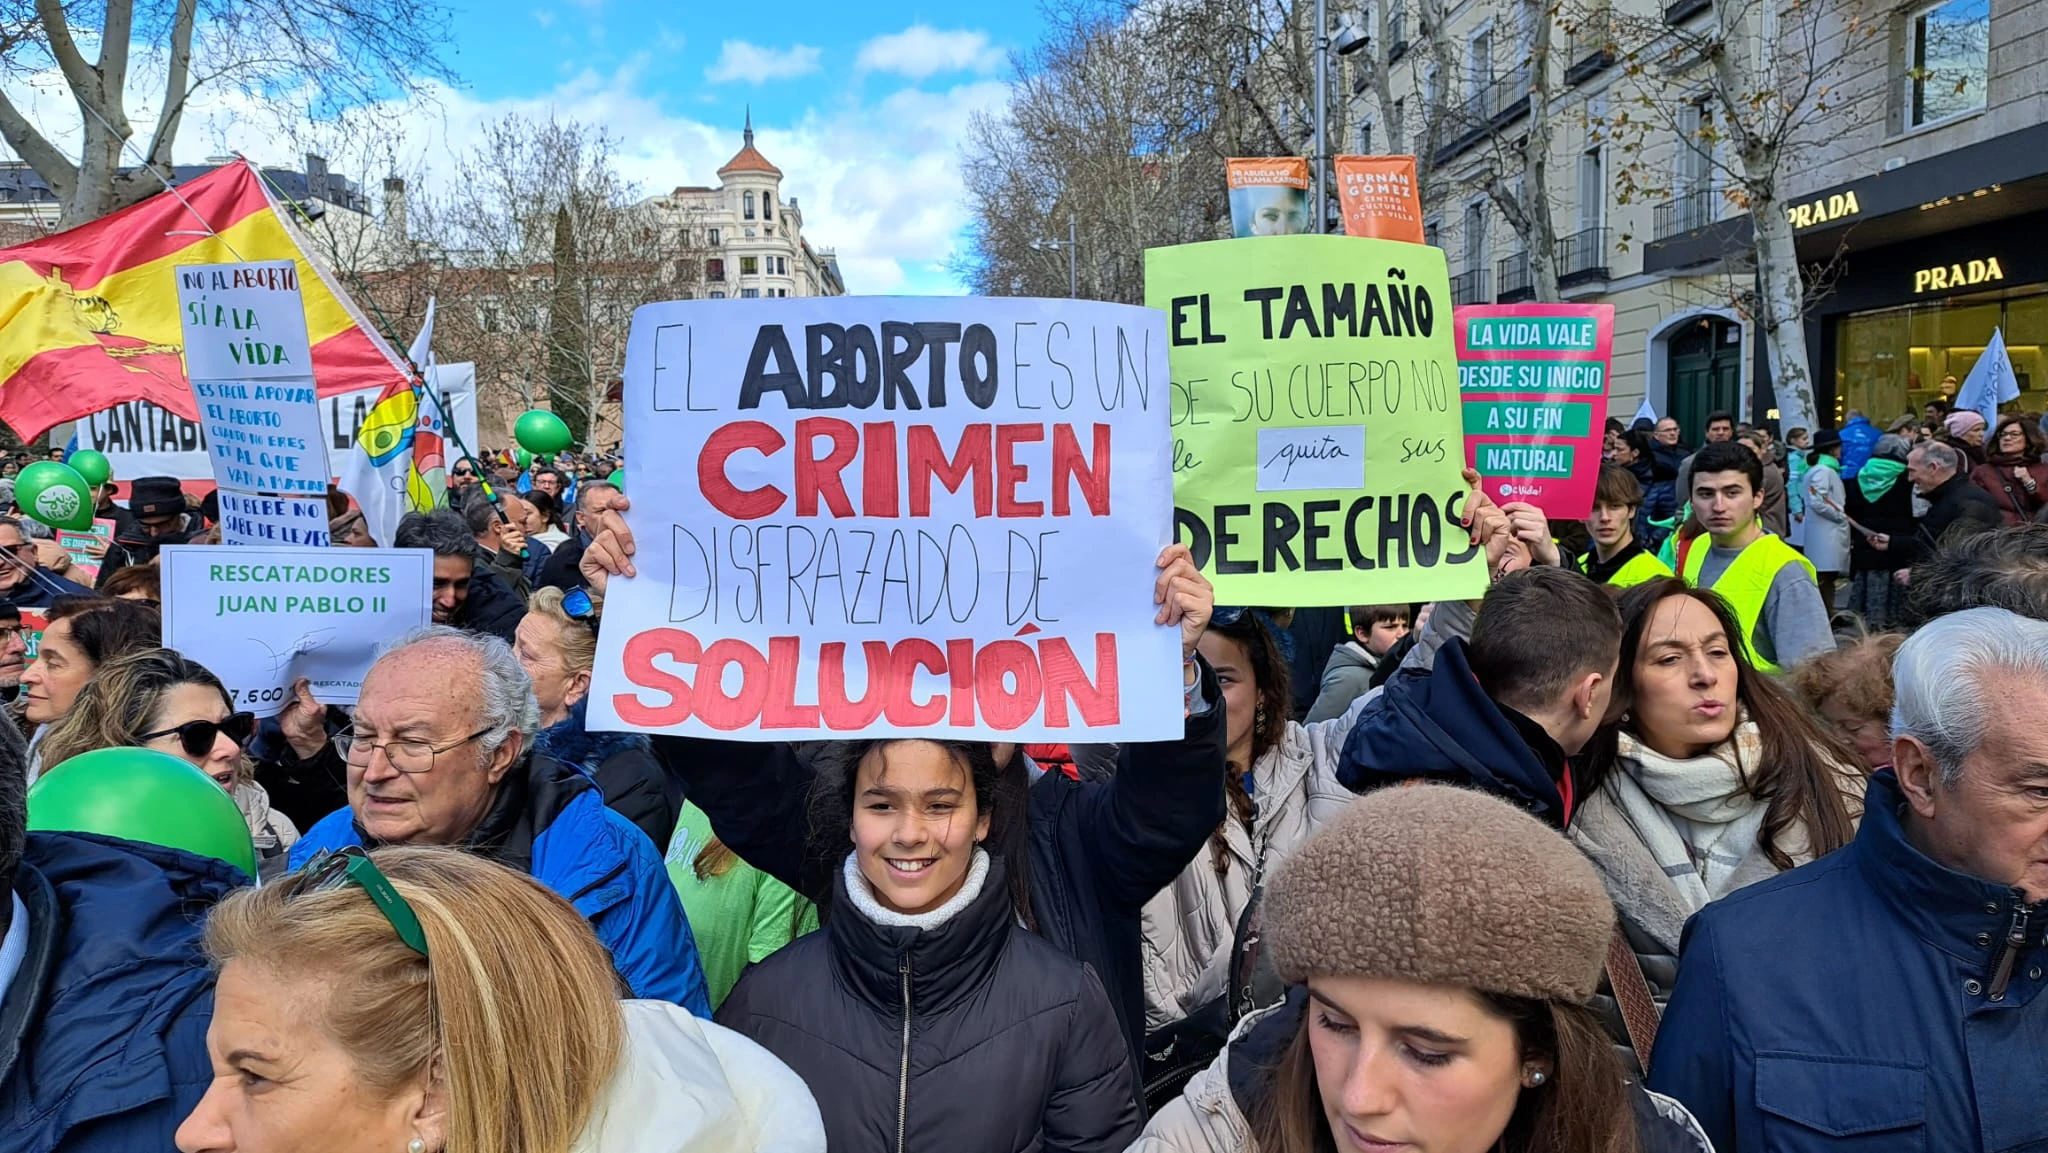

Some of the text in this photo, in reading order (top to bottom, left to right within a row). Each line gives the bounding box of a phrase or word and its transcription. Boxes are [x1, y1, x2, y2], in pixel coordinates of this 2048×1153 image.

[1347, 171, 1409, 185] FERNÁN
[1349, 182, 1410, 198] GÓMEZ
[1360, 203, 1407, 212] CULTURAL
[1364, 196, 1401, 204] CENTRO
[1353, 212, 1366, 220] DE
[1388, 212, 1414, 222] VILLA
[183, 268, 299, 292] NO AL ABORTO
[1914, 256, 2003, 293] PRADA
[188, 294, 261, 332] SÍ A LA
[1172, 266, 1434, 346] EL TAMAÑO
[1472, 324, 1592, 346] LA VIDA VALE
[653, 320, 1150, 412] EL ABORTO ES UN
[1458, 366, 1602, 389] DESDE SU INICIO
[197, 384, 214, 397] ES
[254, 385, 315, 404] APOYAR
[1170, 359, 1448, 427] DE SU CUERPO NO
[207, 404, 281, 428] EL ABORTO
[332, 396, 372, 450] LA
[1487, 407, 1562, 430] A SU FIN
[268, 436, 306, 450] ERES
[236, 447, 256, 466] AL
[260, 452, 300, 472] QUE
[696, 416, 1112, 520] CRIMEN
[1172, 434, 1446, 482] le quita sus
[1486, 448, 1568, 472] NATURAL
[227, 466, 325, 492] VAN A MATAR
[222, 495, 238, 512] UN
[293, 502, 320, 518] NO
[225, 515, 330, 547] SABE DE LEYES
[1173, 490, 1480, 574] DERECHOS
[210, 564, 391, 584] RESCATADORES
[668, 524, 1061, 627] DISFRAZADO DE
[216, 596, 386, 616] JUAN PABLO II
[612, 622, 1121, 732] SOLUCIÓN
